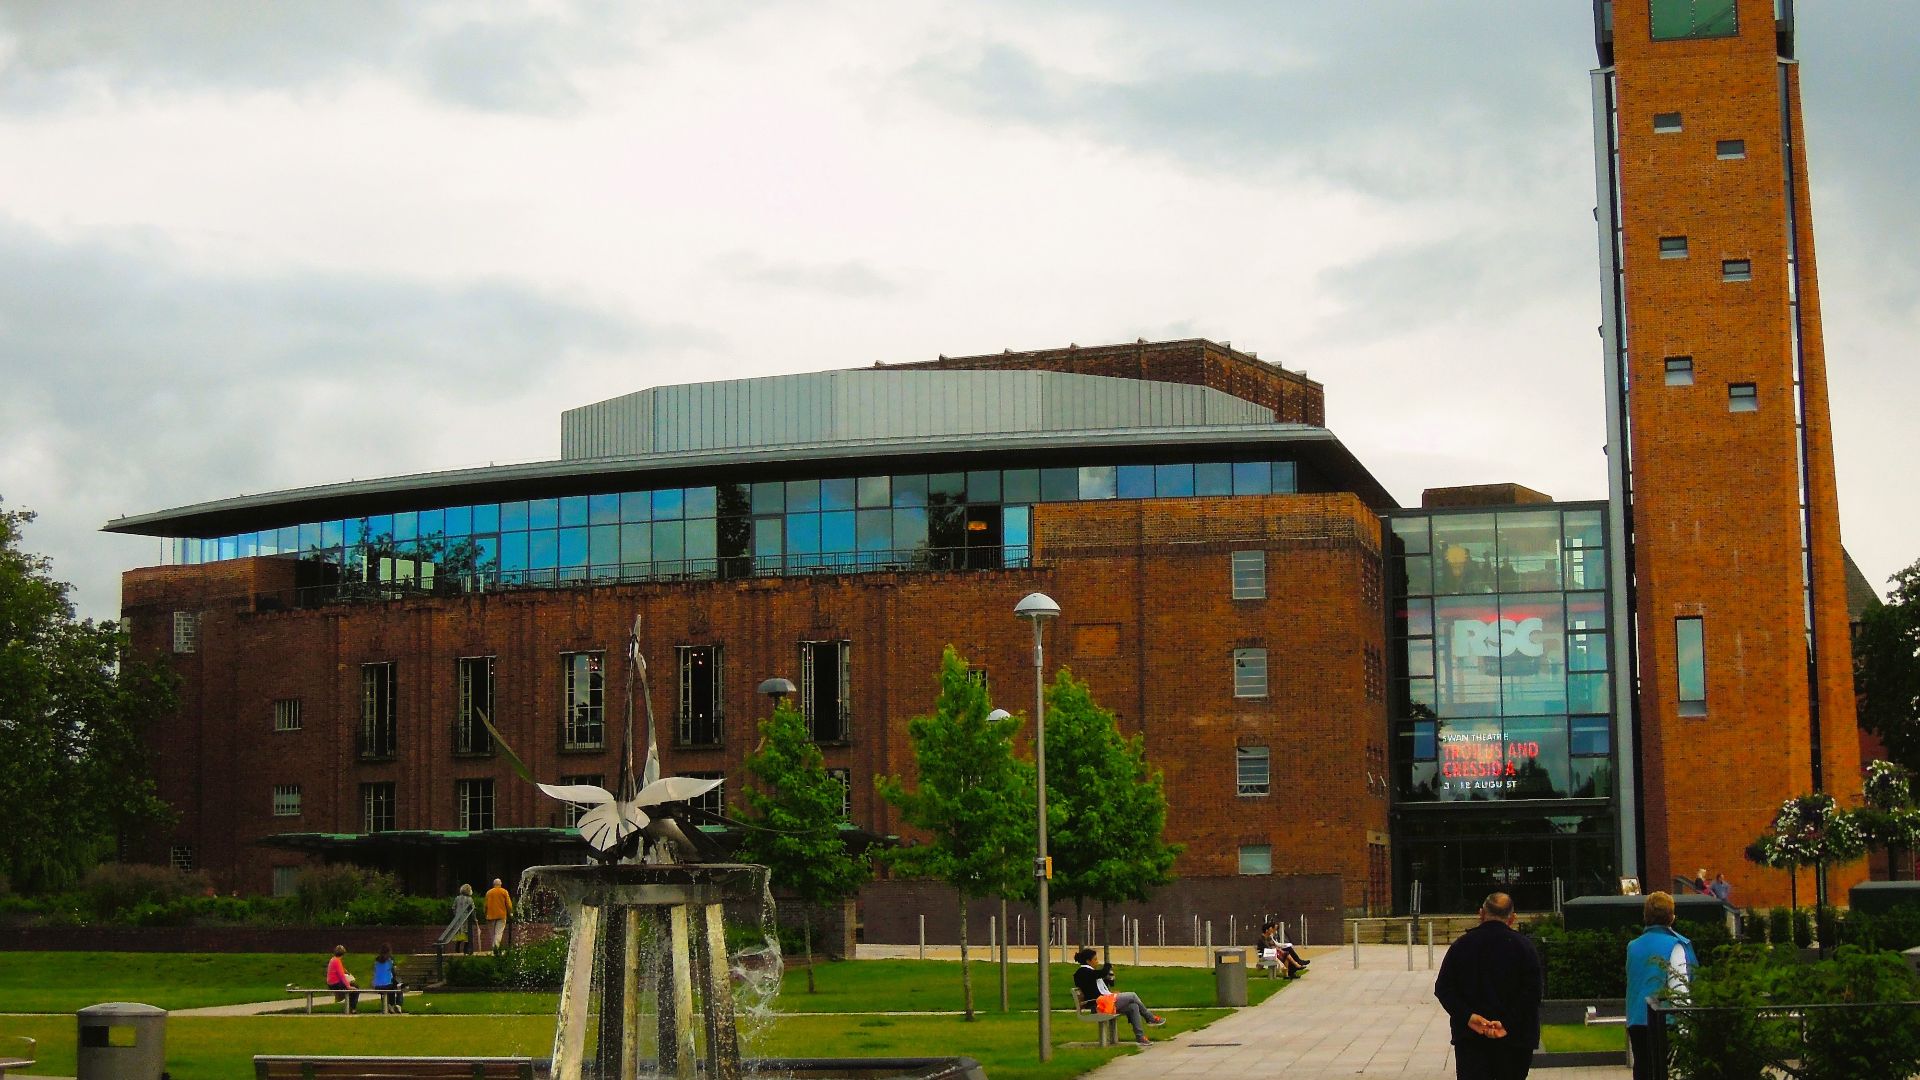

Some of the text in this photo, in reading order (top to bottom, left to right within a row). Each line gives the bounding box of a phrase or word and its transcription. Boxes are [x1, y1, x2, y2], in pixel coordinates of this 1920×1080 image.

[1454, 617, 1544, 658] RSC
[1442, 732, 1509, 742] SWAN THEATRE
[1443, 741, 1539, 760] TROILUS AND
[1443, 759, 1517, 778] CRESSIDA
[1474, 780, 1518, 789] AUGUST
